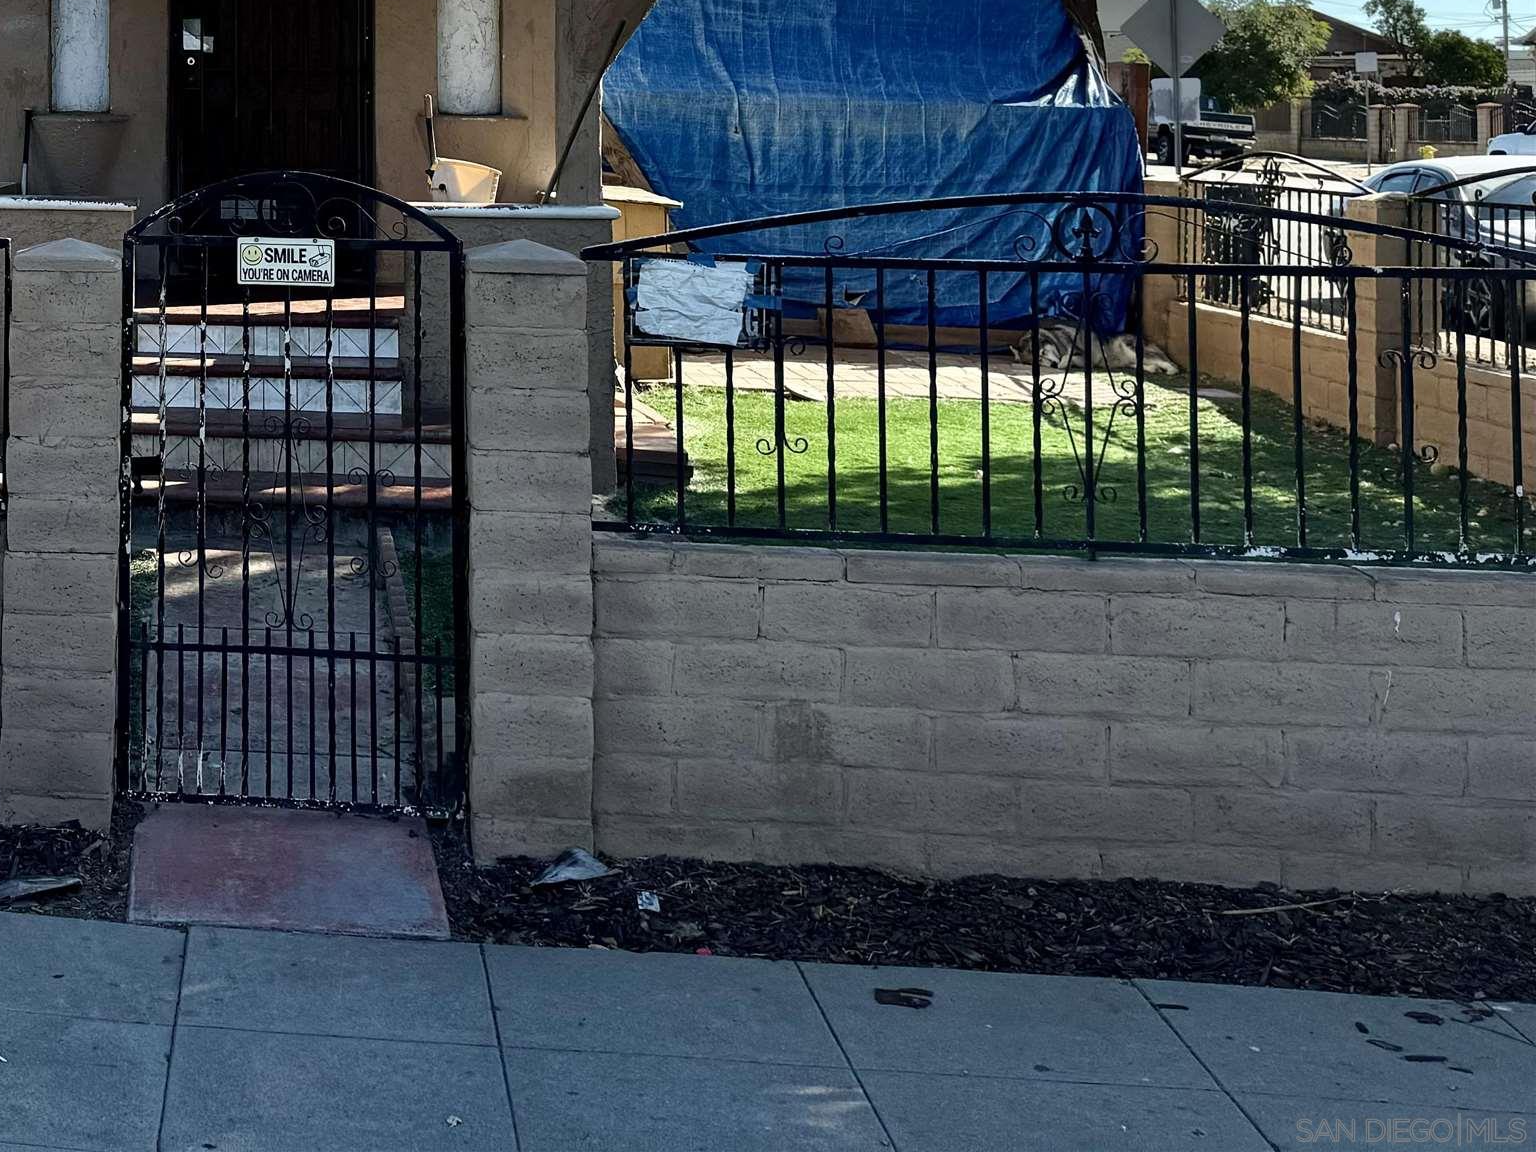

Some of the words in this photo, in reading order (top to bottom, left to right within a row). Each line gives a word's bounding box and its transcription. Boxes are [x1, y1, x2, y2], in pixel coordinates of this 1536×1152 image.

[264, 247, 307, 264] SMILE
[242, 268, 274, 280] YOU'RE
[276, 268, 289, 280] ON
[292, 269, 329, 281] CAMERA
